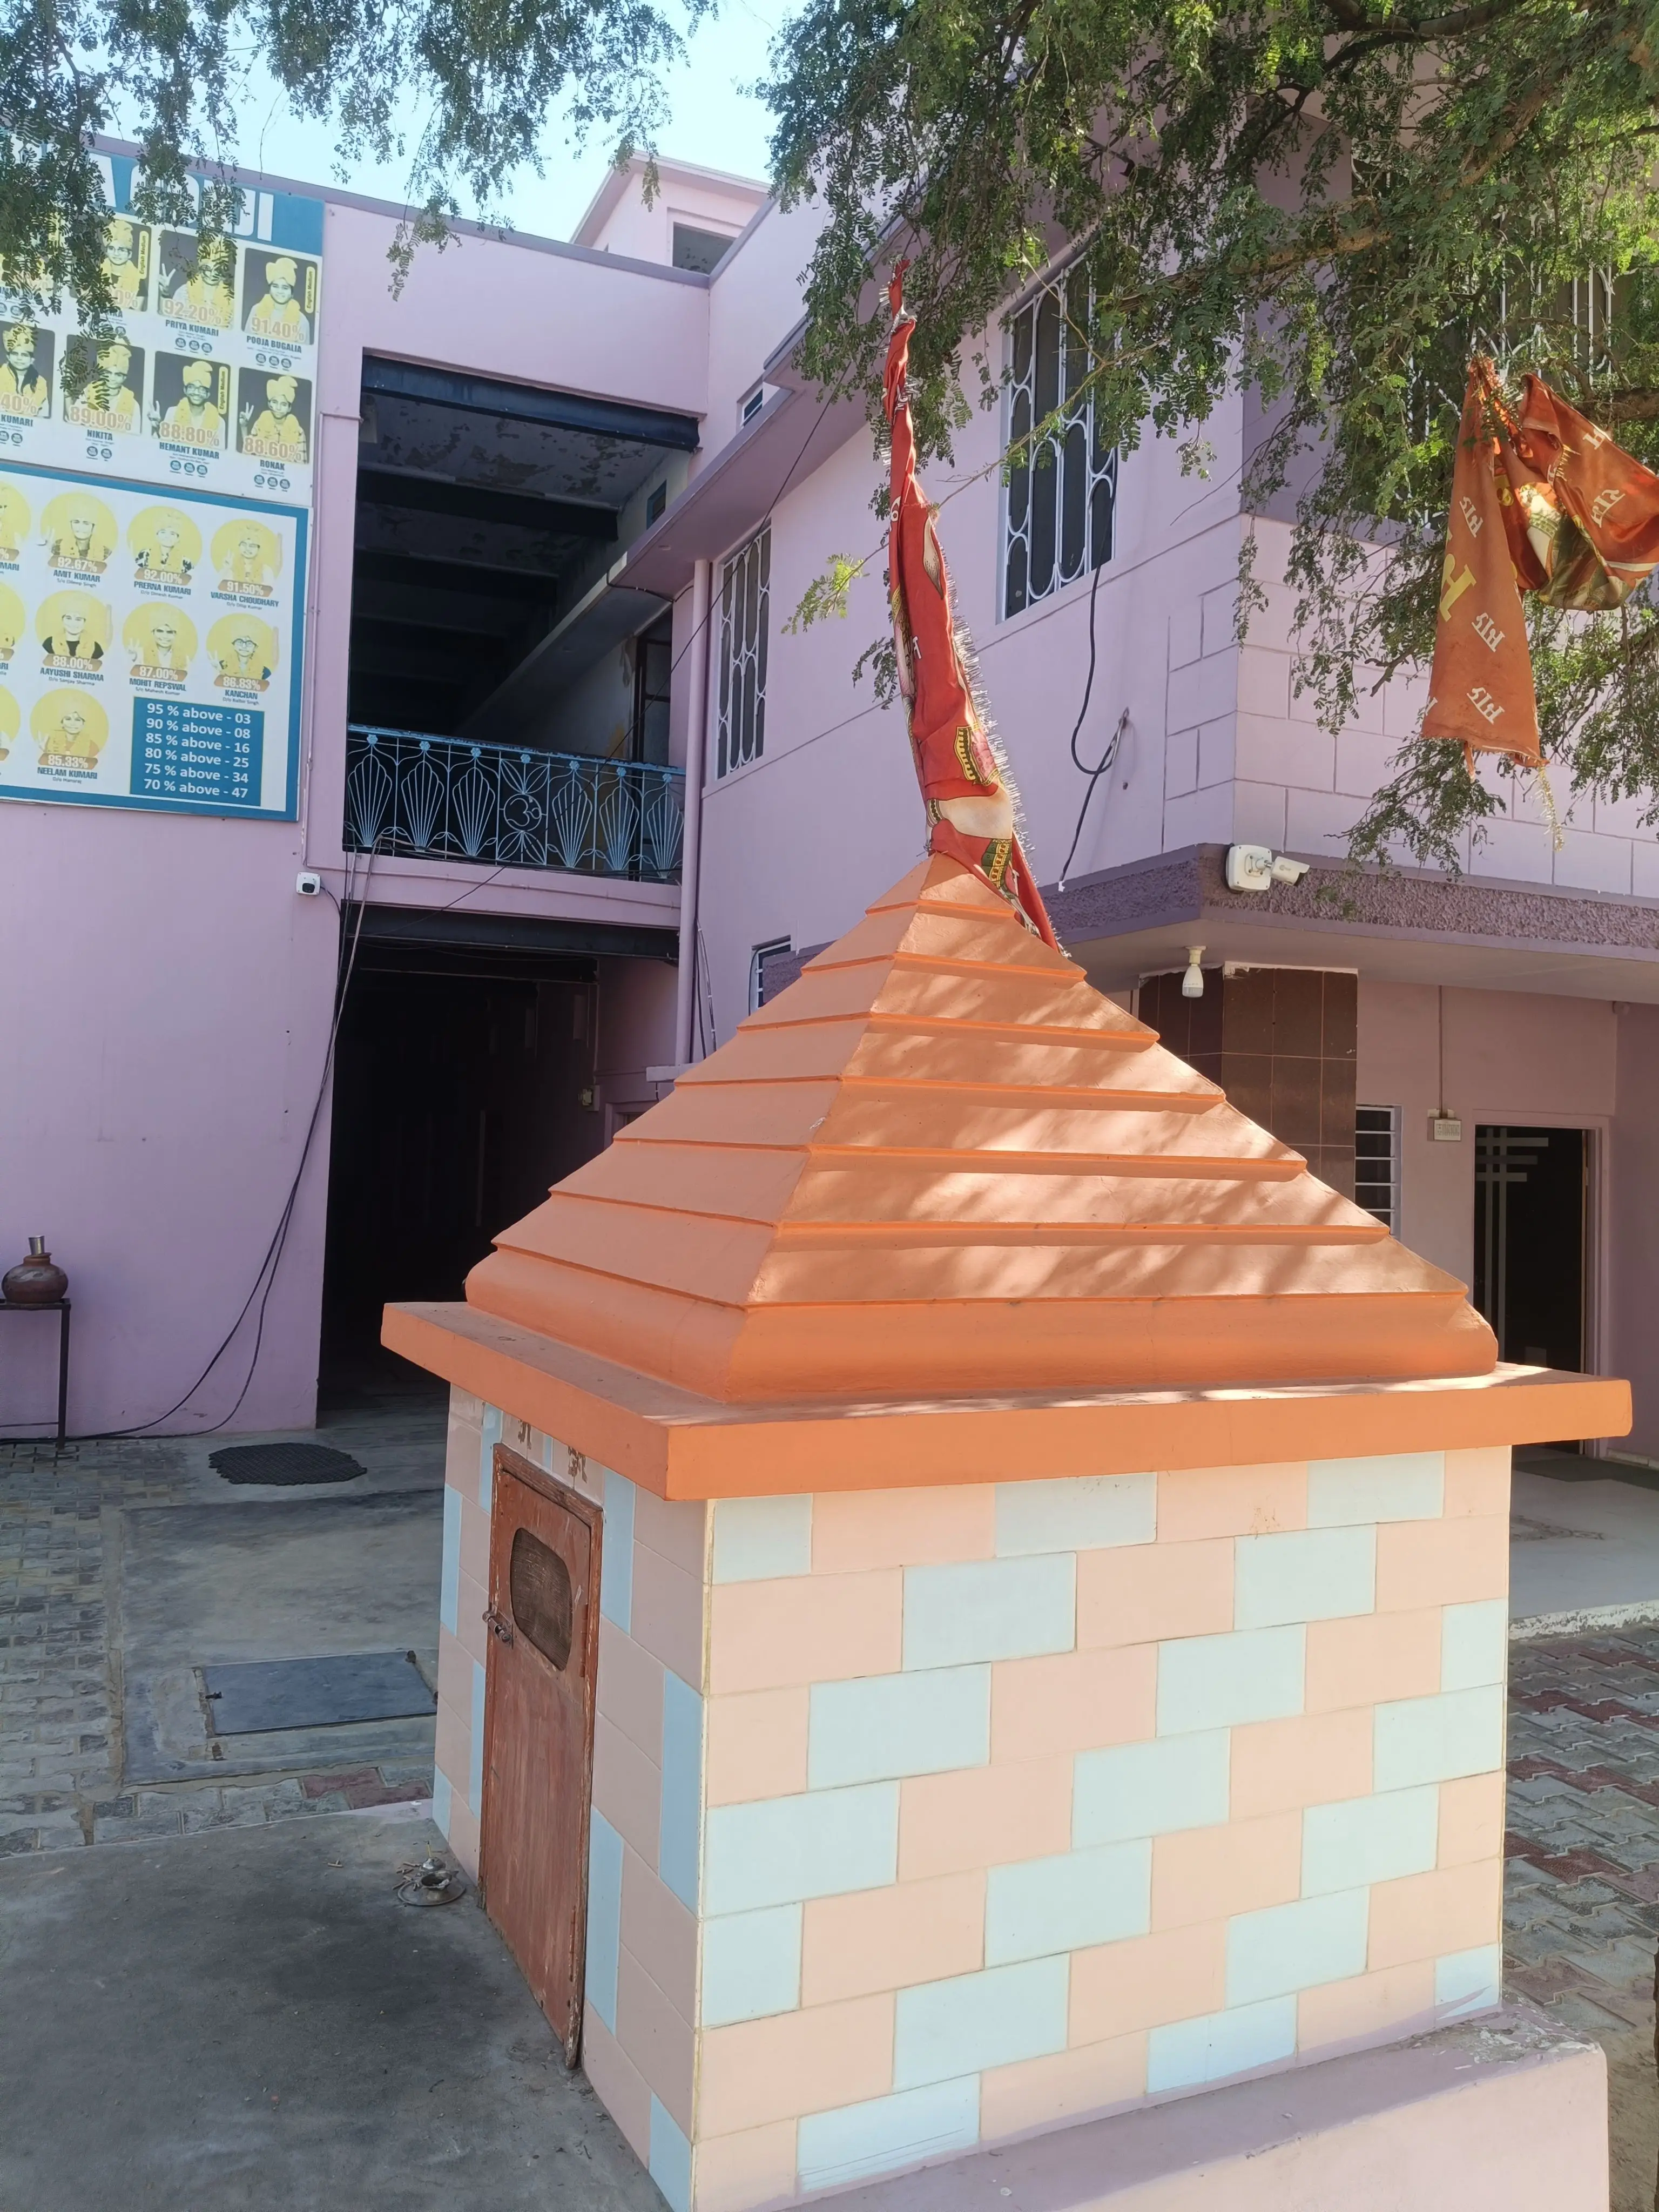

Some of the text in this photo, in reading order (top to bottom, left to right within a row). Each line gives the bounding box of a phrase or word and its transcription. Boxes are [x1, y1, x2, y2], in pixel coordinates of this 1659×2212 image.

[164, 300, 221, 324] 92.20%
[165, 319, 187, 331] PRIYA
[189, 324, 219, 336] KUMARI
[252, 317, 304, 341] 91.40%
[246, 335, 269, 347] POOJA
[271, 340, 301, 353] BUGALIA
[1, 414, 33, 427] KUMARI
[70, 406, 131, 431] 89.00%
[87, 429, 112, 441] NIKITA
[161, 422, 219, 447] 88.80%
[159, 442, 191, 454] HEMANT
[192, 448, 219, 459] KUMAR
[245, 437, 301, 461] 88.60%
[260, 460, 285, 470] RONAK
[57, 557, 98, 572] 92.67%
[53, 570, 100, 582] AMIT KUMAR
[144, 569, 183, 584] 92.00%
[134, 581, 191, 595] PRERNA KUMARI
[227, 581, 264, 596] 91.50%
[211, 592, 279, 607] VARSHA CHOUDHARY
[53, 656, 93, 670] 88.00%
[41, 667, 104, 682] AAYUSHI SHARMA
[140, 666, 178, 680] 87.00%
[130, 678, 186, 691] MOHIT REPSWAL
[225, 690, 258, 699] KANCHAN
[147, 703, 164, 714] 95
[167, 705, 179, 716] %
[183, 707, 223, 721] above
[235, 713, 251, 724] 03
[146, 718, 163, 729] 90
[166, 720, 178, 731] %
[182, 722, 222, 736] above
[234, 727, 251, 739] 08
[145, 733, 162, 744] 85
[166, 734, 178, 746] %
[181, 737, 222, 750] above
[234, 743, 250, 753] 16
[48, 754, 88, 768] 85.33%
[145, 747, 161, 759] 80
[165, 750, 177, 760] %
[180, 752, 221, 765] above
[233, 757, 249, 768] 25
[37, 767, 97, 779] NEELAM KUMARI
[144, 763, 160, 774] 75
[164, 765, 177, 776] %
[180, 767, 220, 780] above
[232, 772, 248, 783] 34
[144, 778, 160, 790] 70
[164, 780, 176, 791] %
[179, 783, 220, 795] above
[232, 787, 248, 798] 47
